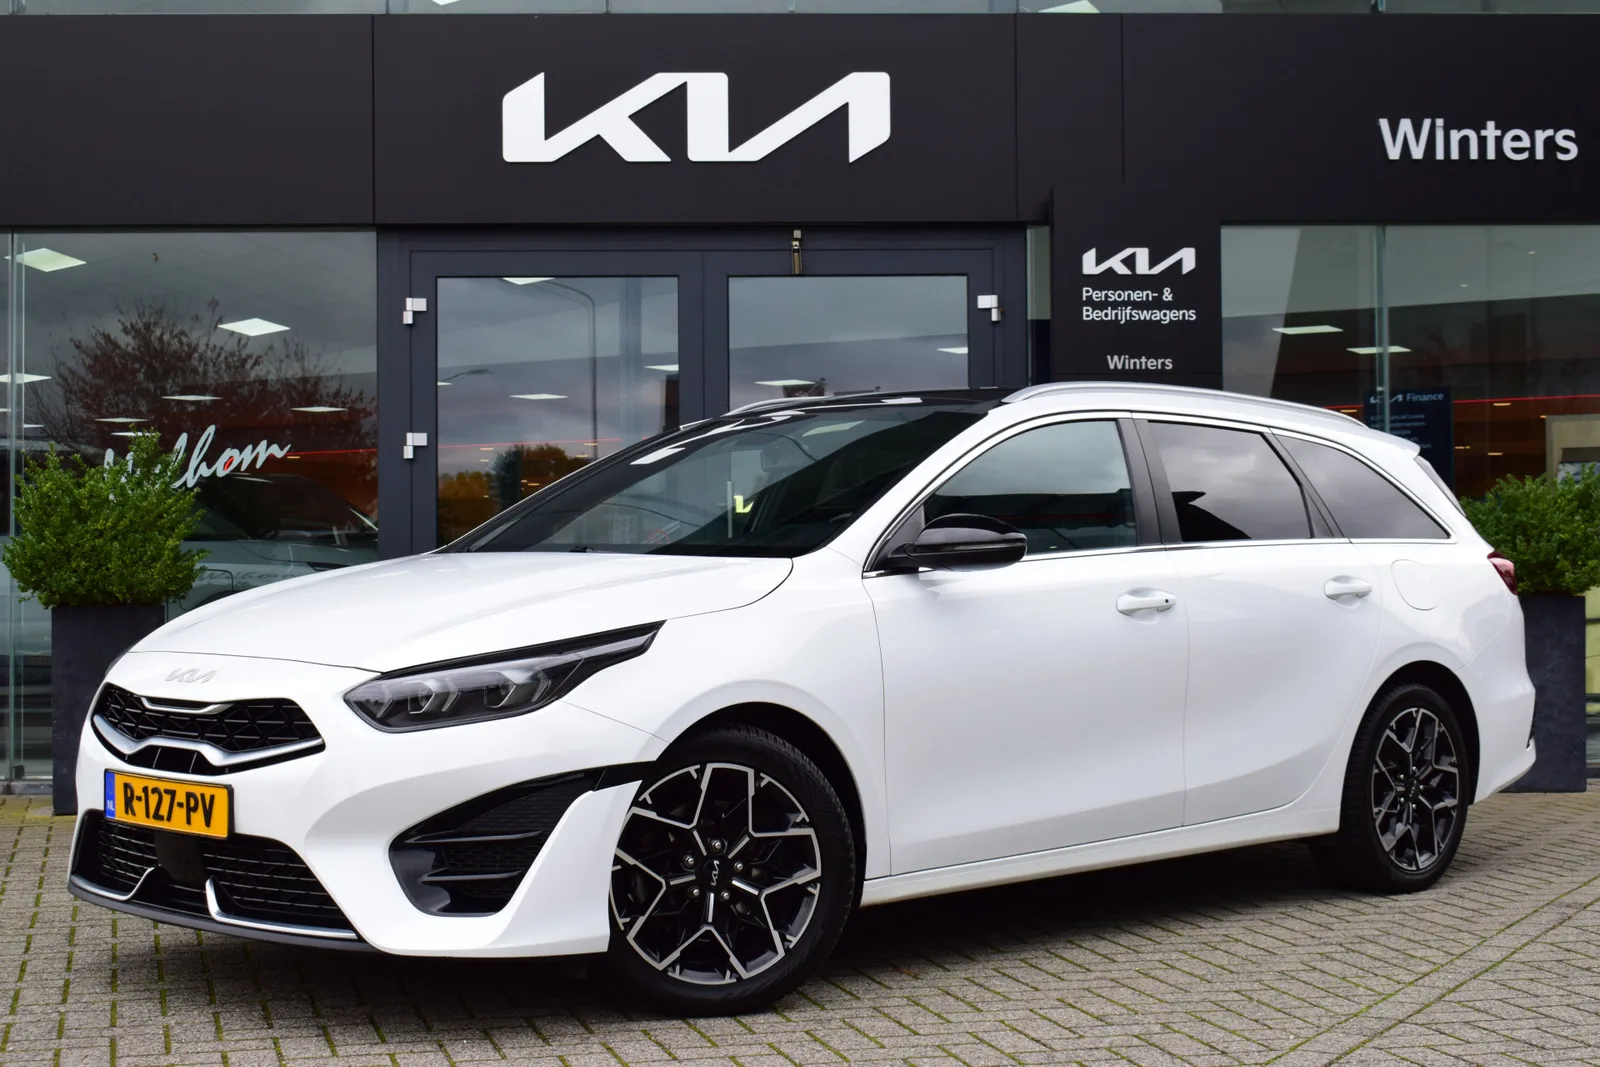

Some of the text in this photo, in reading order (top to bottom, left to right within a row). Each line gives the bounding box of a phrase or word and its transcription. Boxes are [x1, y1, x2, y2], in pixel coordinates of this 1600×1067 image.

[502, 71, 891, 163] KIA
[1378, 118, 1579, 161] Winters
[1082, 247, 1196, 275] KIA
[1082, 287, 1173, 301] Personen- &
[1082, 306, 1196, 324] Bedrijfswagens
[1106, 355, 1173, 370] Winters
[1370, 393, 1444, 404] KA Finance
[165, 668, 217, 684] KIA
[107, 800, 115, 811] NL
[123, 782, 215, 828] R-127-PV
